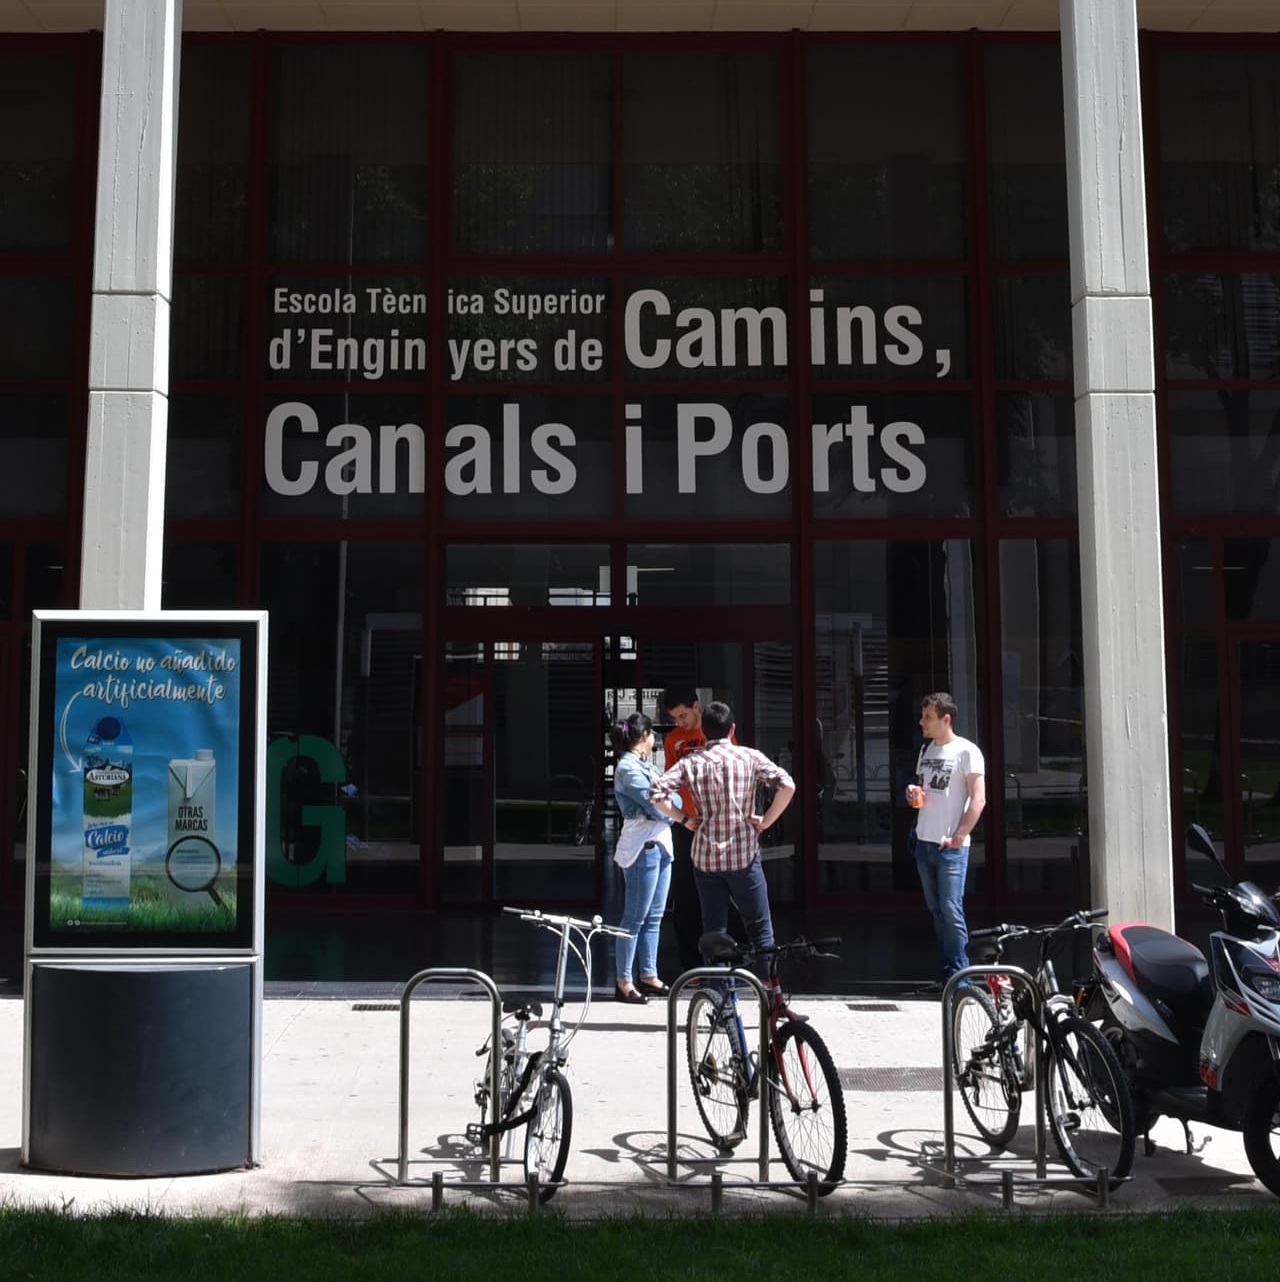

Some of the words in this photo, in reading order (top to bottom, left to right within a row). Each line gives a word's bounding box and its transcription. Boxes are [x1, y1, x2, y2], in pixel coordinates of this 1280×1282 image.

[274, 288, 356, 314] Escola
[365, 287, 484, 315] Tècnica
[494, 288, 606, 320] Superior
[554, 329, 603, 371] de
[624, 288, 951, 378] Camins,
[264, 401, 577, 496] Canals
[625, 403, 643, 494] i
[677, 402, 927, 494] Ports
[70, 645, 132, 671] Calcio
[136, 656, 156, 673] no
[161, 649, 238, 673] añadido
[83, 673, 225, 709] artificialmente
[175, 819, 208, 831] MARCAS
[178, 806, 203, 818] OTRAS
[267, 734, 346, 887] G
[87, 829, 124, 848] Calcio
